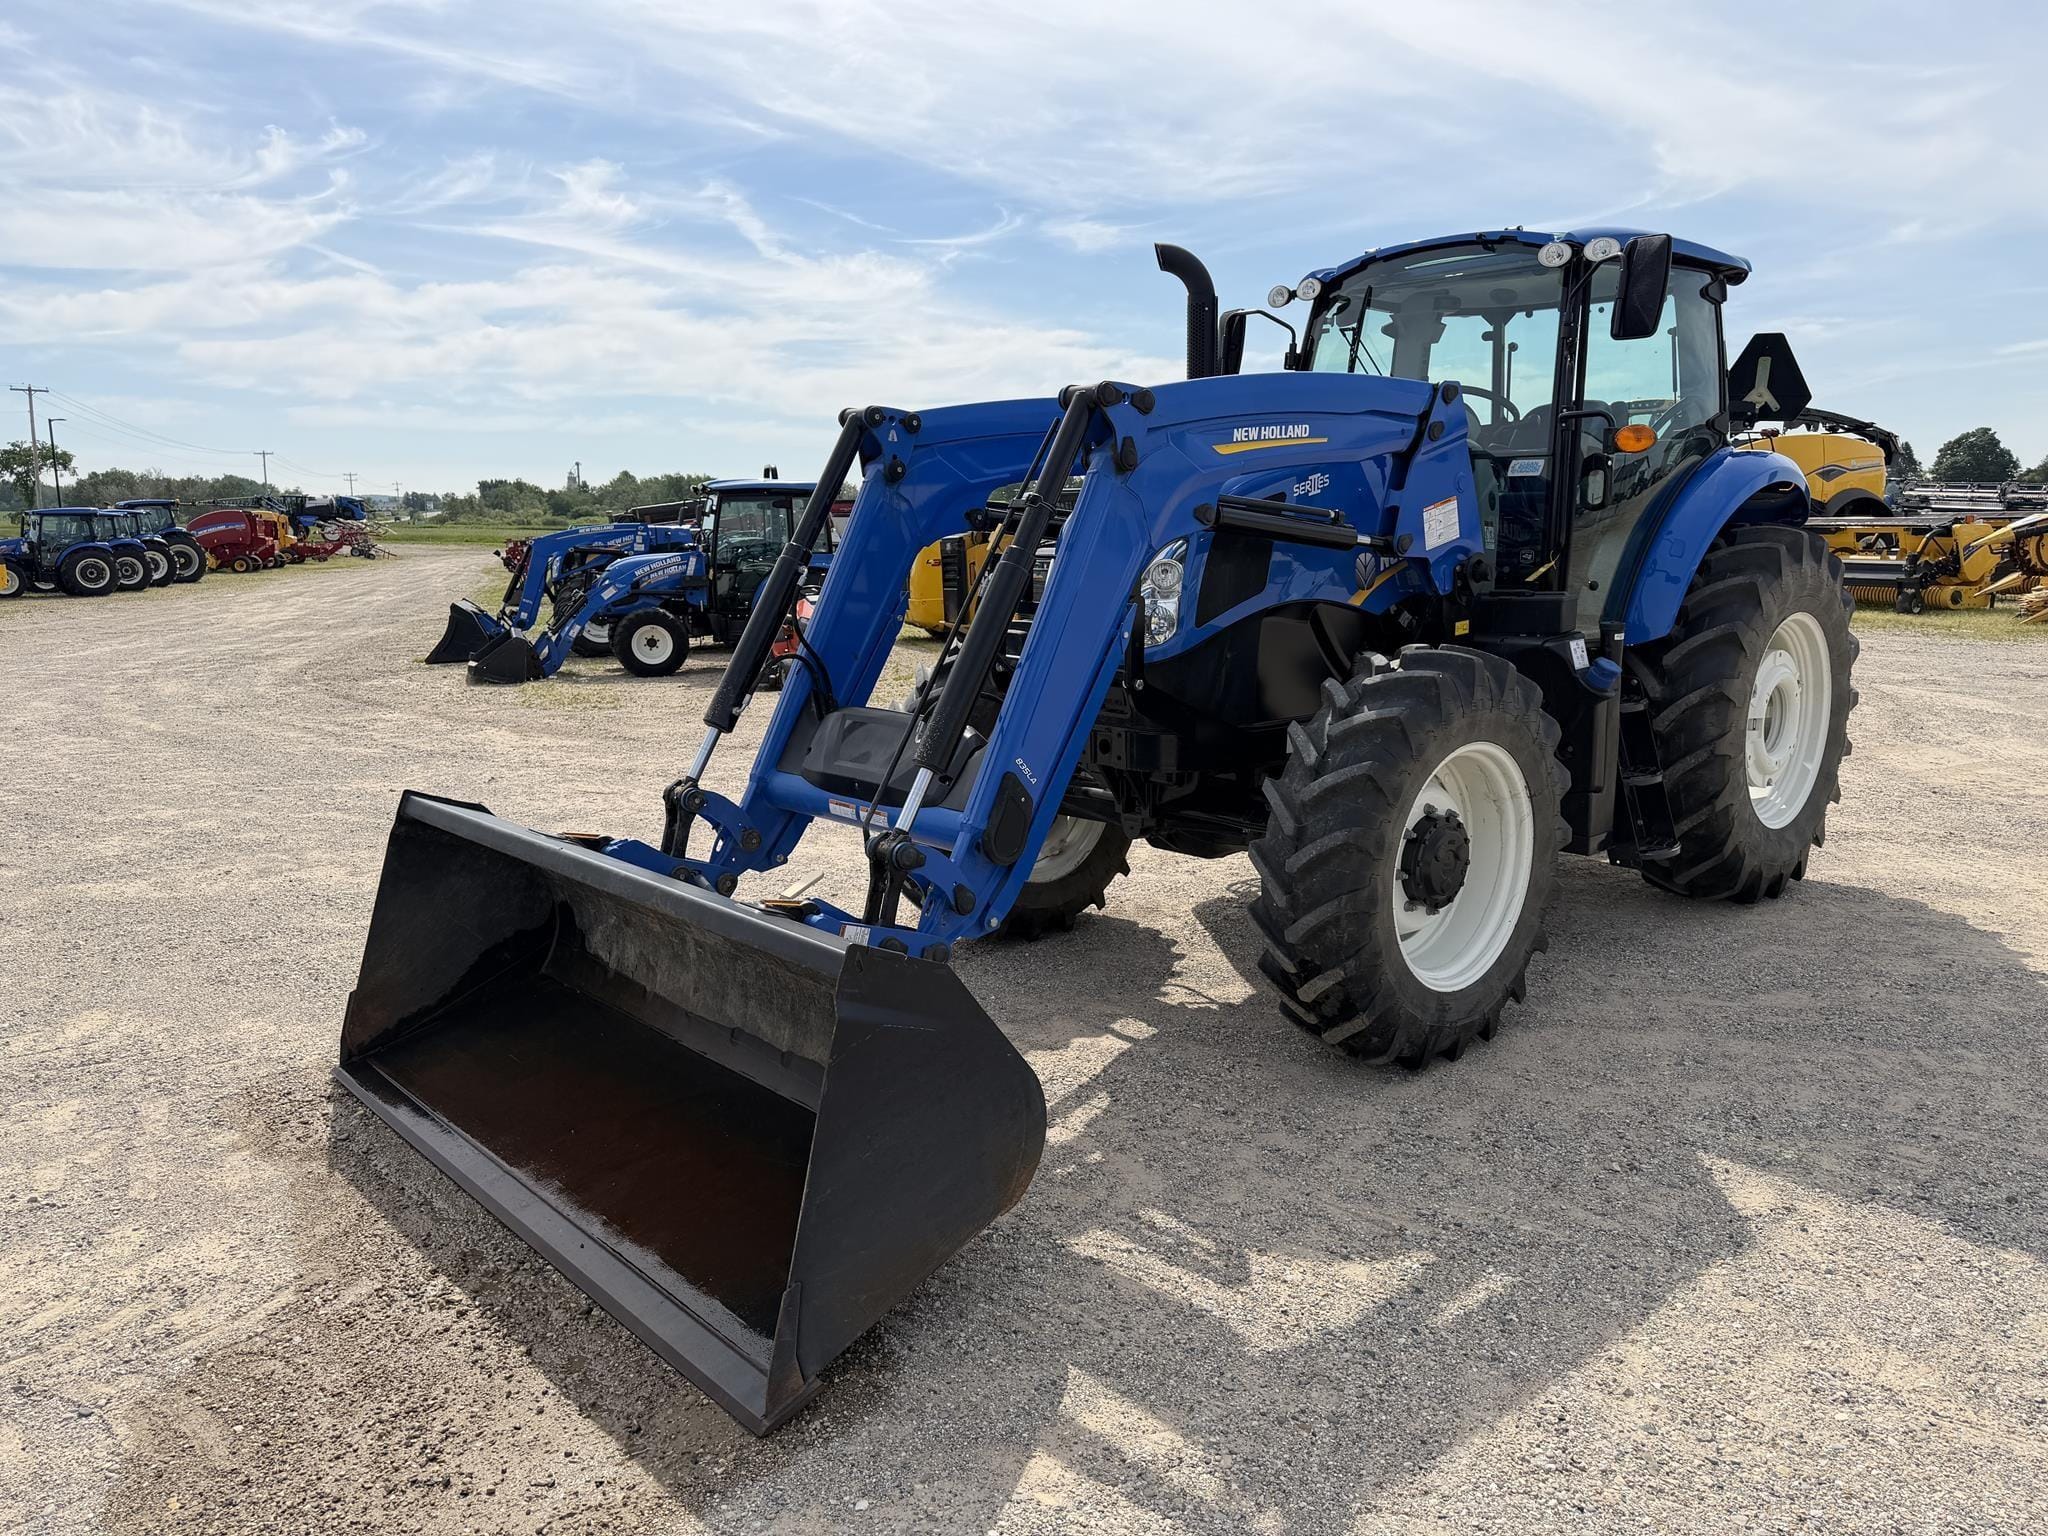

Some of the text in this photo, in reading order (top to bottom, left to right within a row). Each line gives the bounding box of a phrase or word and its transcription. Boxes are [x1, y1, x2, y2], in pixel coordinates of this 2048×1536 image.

[1233, 424, 1310, 442] NEW HOLLAND
[634, 565, 650, 577] NEW
[650, 555, 682, 570] HOLLAND
[1015, 757, 1037, 785] 835LA
